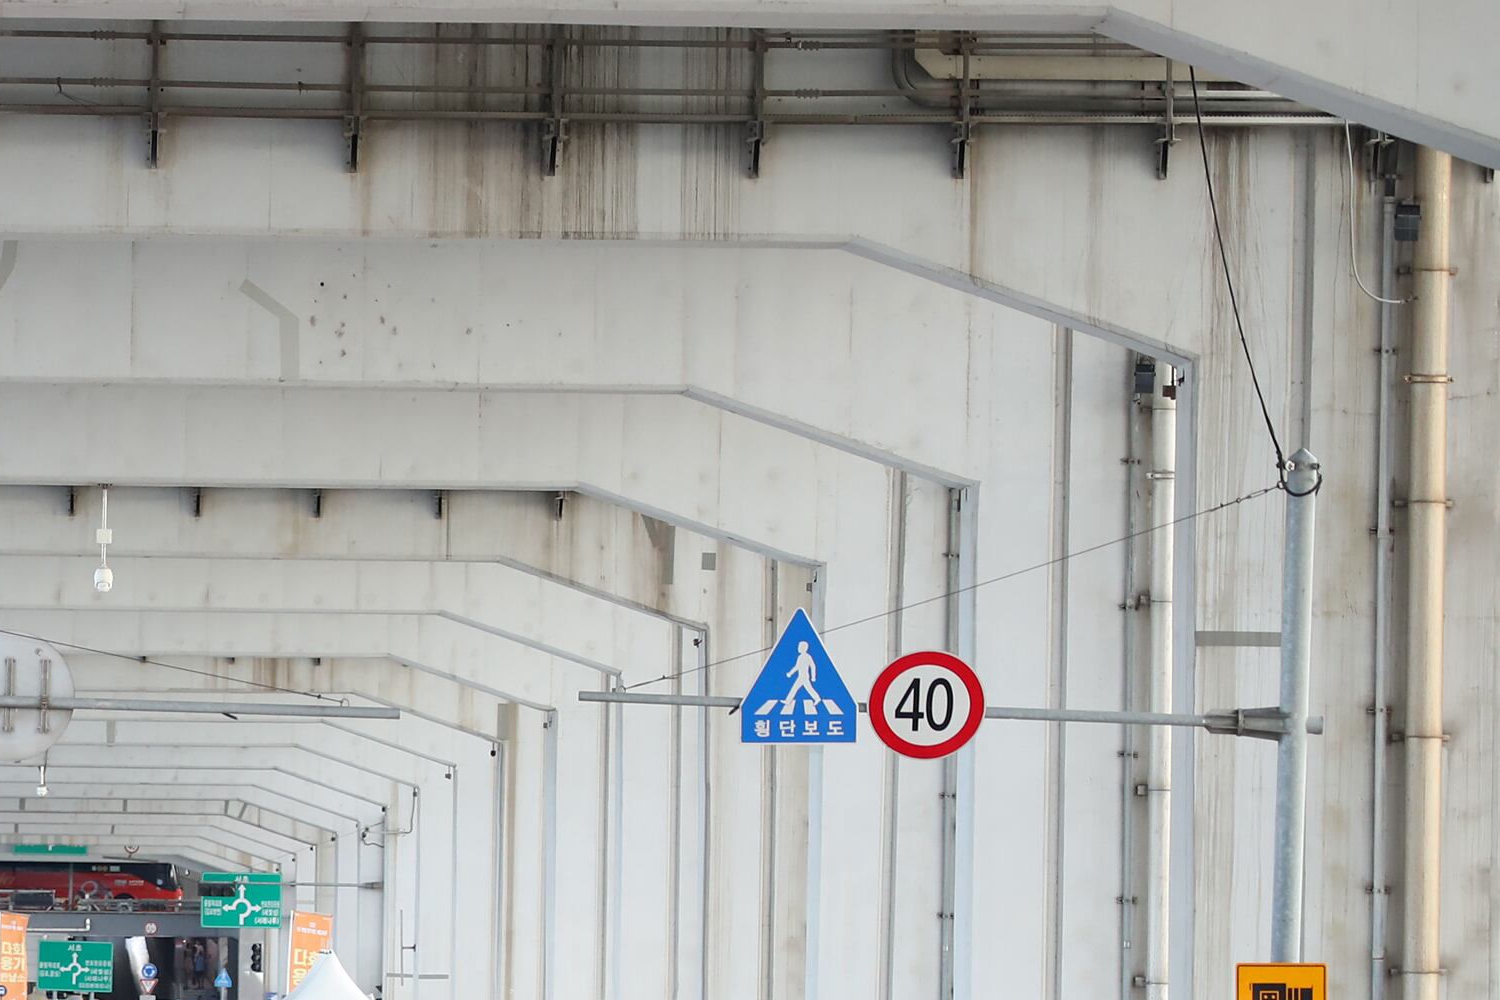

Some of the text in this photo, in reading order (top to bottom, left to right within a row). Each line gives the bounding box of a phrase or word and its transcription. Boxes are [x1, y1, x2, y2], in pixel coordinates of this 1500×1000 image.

[894, 677, 954, 732] 40
[754, 719, 845, 738] 횡단보도
[1, 941, 25, 955] 다회
[67, 943, 83, 952] 서초
[1, 956, 25, 971] 용기
